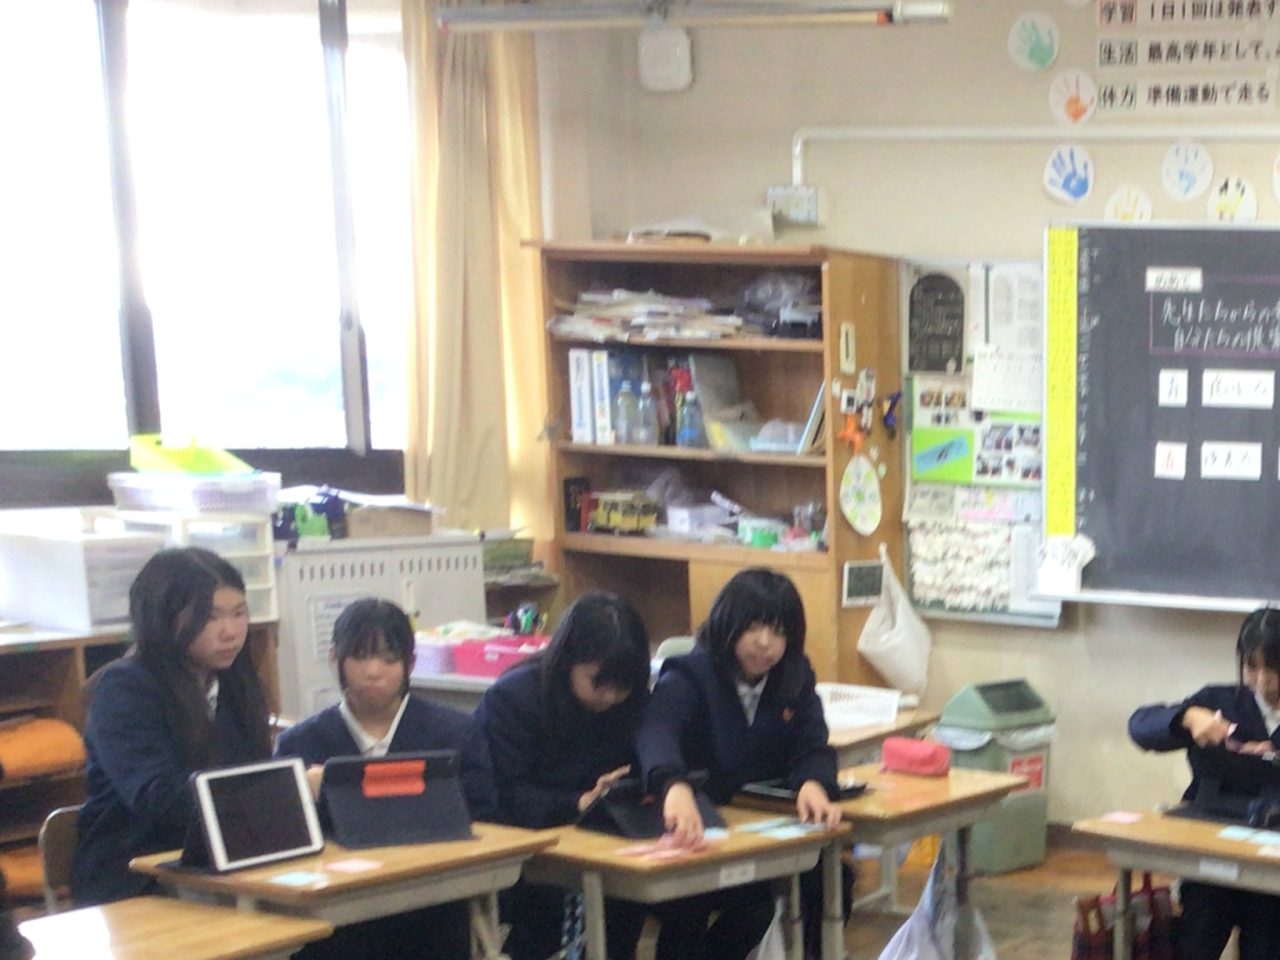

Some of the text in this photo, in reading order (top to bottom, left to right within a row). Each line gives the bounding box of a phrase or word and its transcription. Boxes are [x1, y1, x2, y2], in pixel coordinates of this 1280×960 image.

[1102, 0, 1136, 22] 学習
[1102, 41, 1136, 64] 生活
[1102, 85, 1135, 108] 体力
